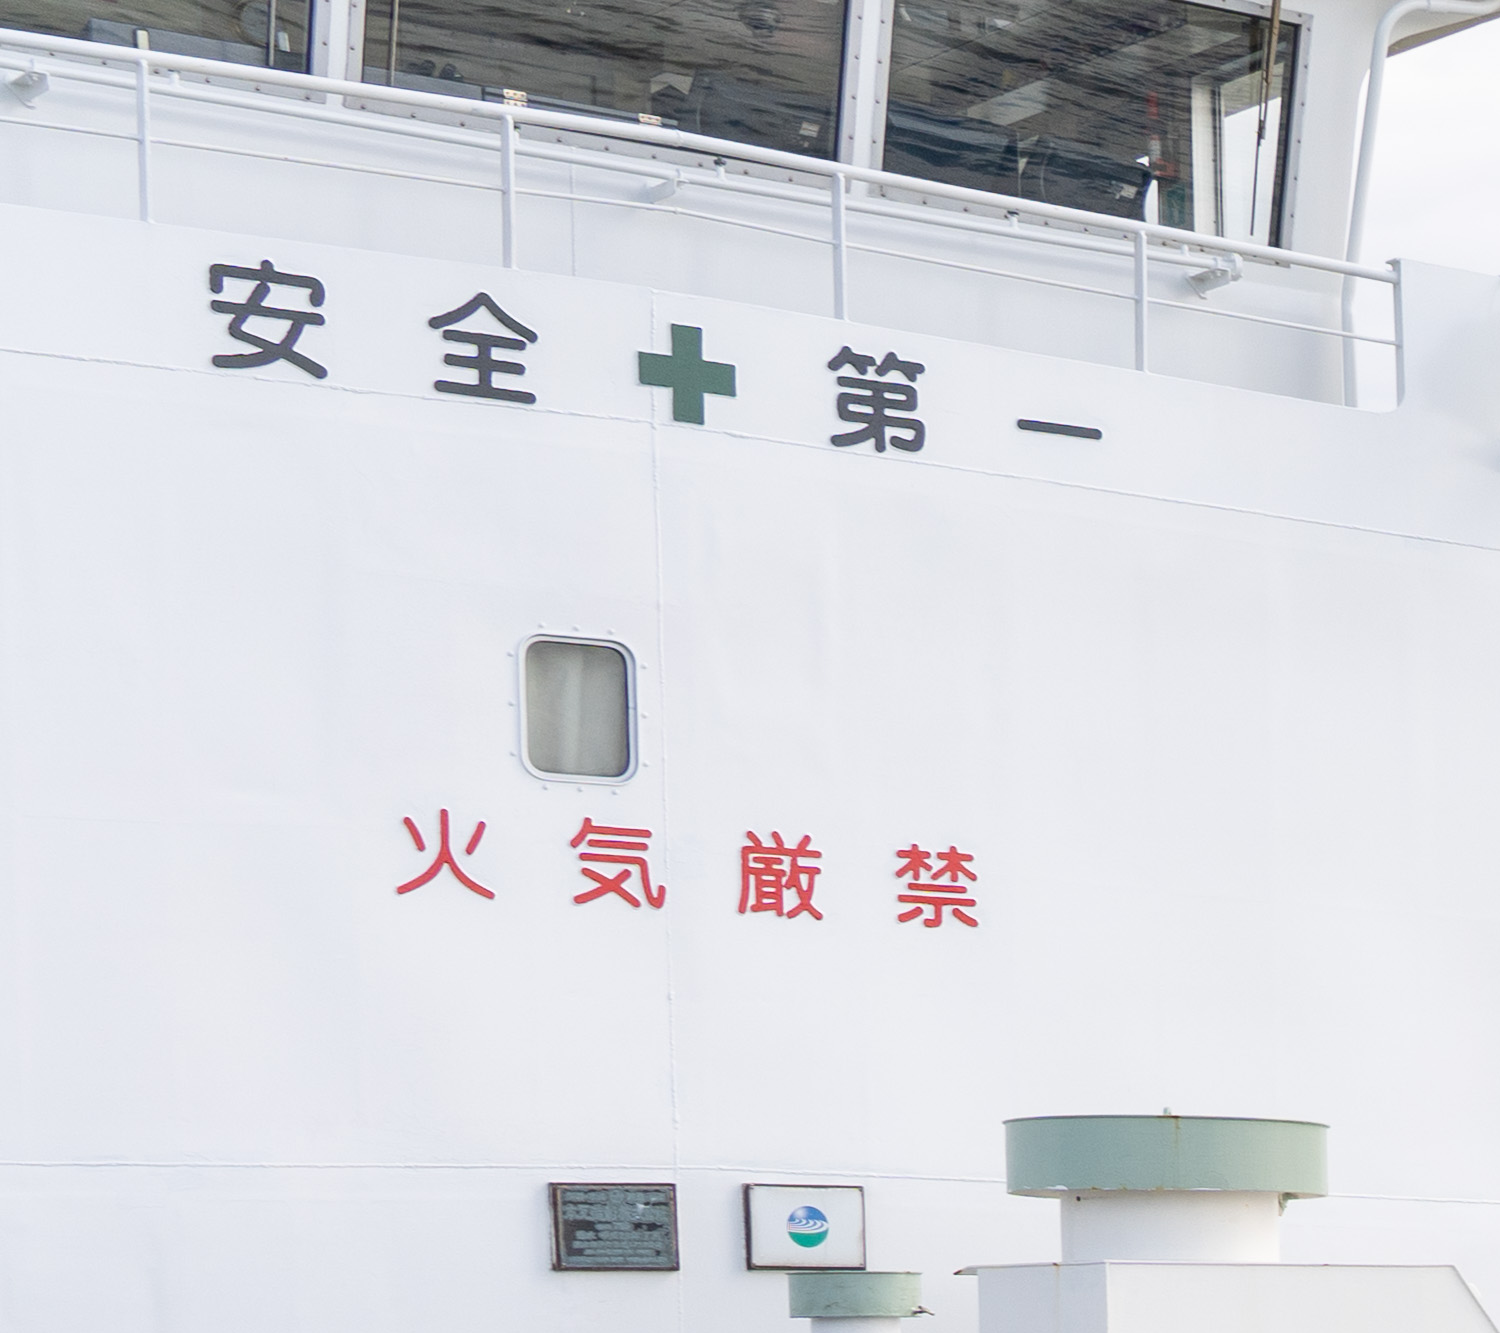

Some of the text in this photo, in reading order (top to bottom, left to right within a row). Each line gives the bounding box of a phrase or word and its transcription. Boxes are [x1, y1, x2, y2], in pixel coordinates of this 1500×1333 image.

[209, 260, 1103, 453] 安全 第一
[397, 809, 979, 929] 火気厳禁
